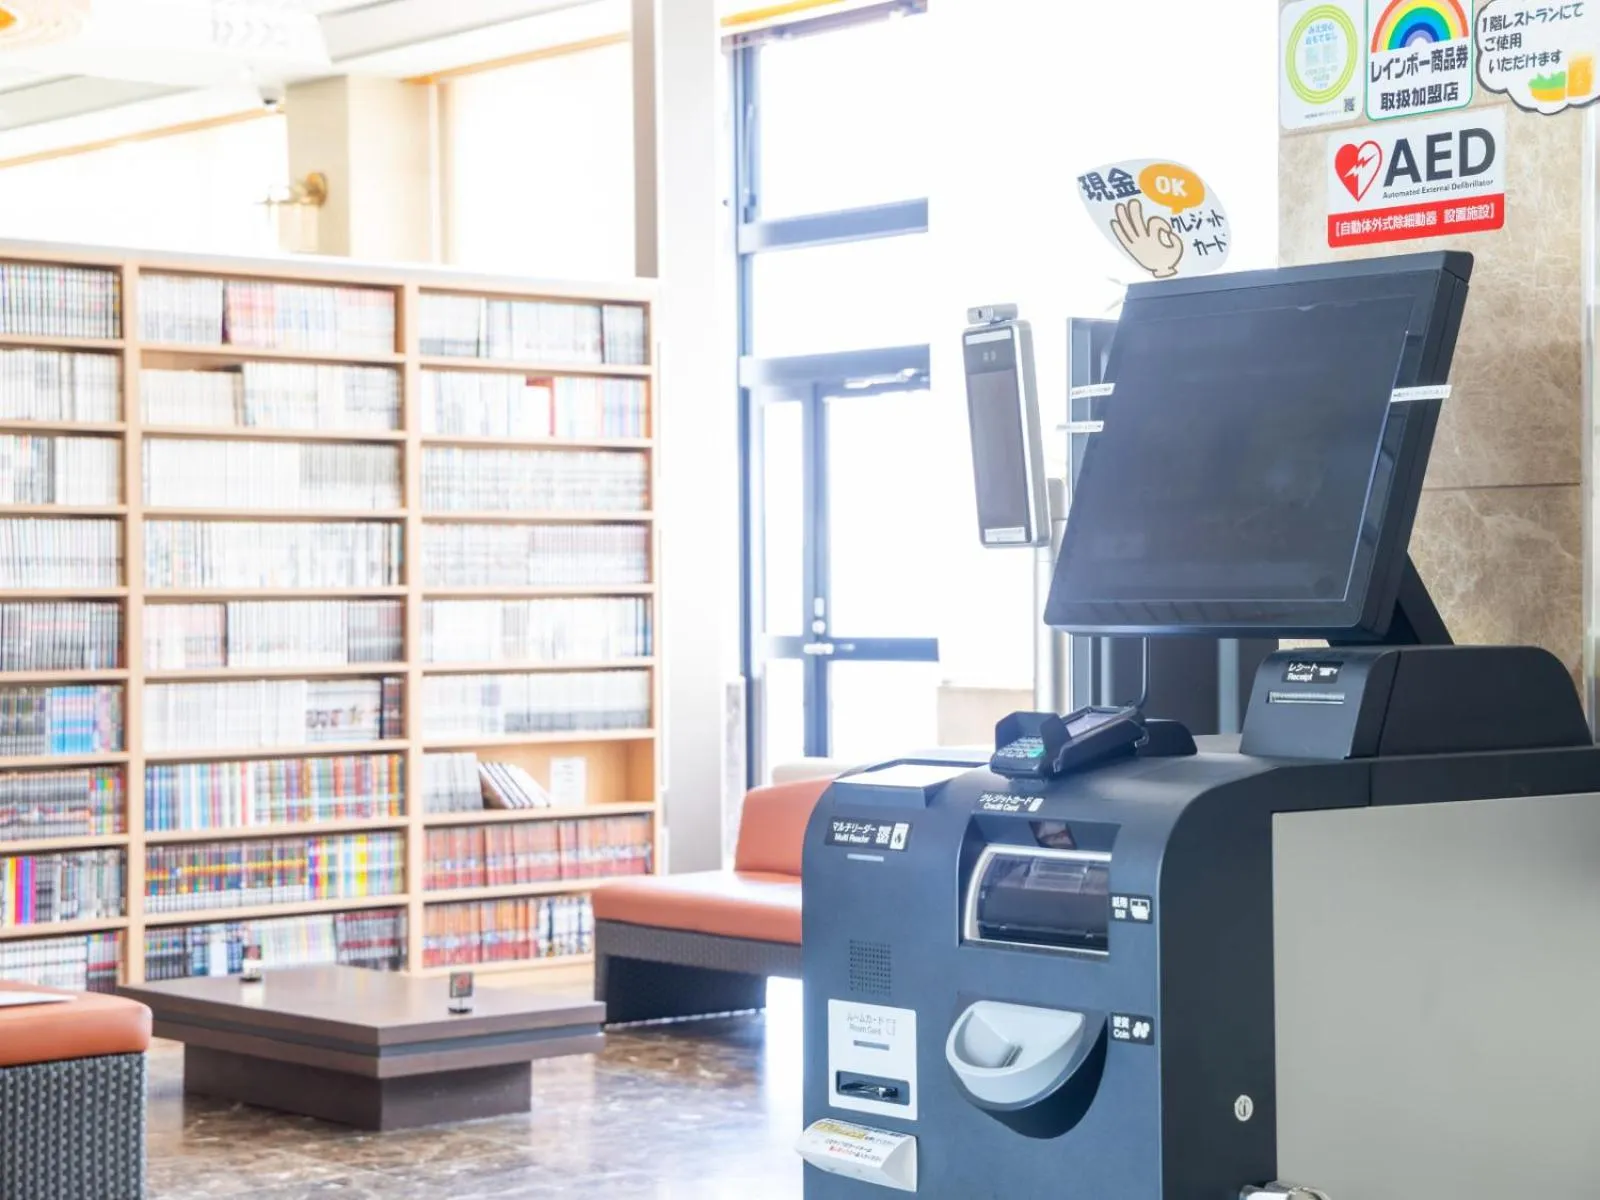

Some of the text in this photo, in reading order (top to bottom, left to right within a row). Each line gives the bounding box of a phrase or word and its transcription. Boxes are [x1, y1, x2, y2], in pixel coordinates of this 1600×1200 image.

[1482, 2, 1584, 33] 1階レストランにて
[1484, 32, 1522, 52] ご使用
[1371, 44, 1469, 83] レインボー商品券
[1489, 49, 1563, 74] いただけます
[1380, 82, 1459, 111] 取扱加盟店
[1383, 127, 1496, 188] AED
[1077, 167, 1142, 201] 現金
[1155, 175, 1188, 197] OK
[1383, 179, 1494, 199] Automated External Defibrillator
[1170, 209, 1225, 234] クレジット
[1192, 233, 1227, 256] カード
[1287, 672, 1313, 682] Receipt
[1288, 662, 1318, 672] レシート
